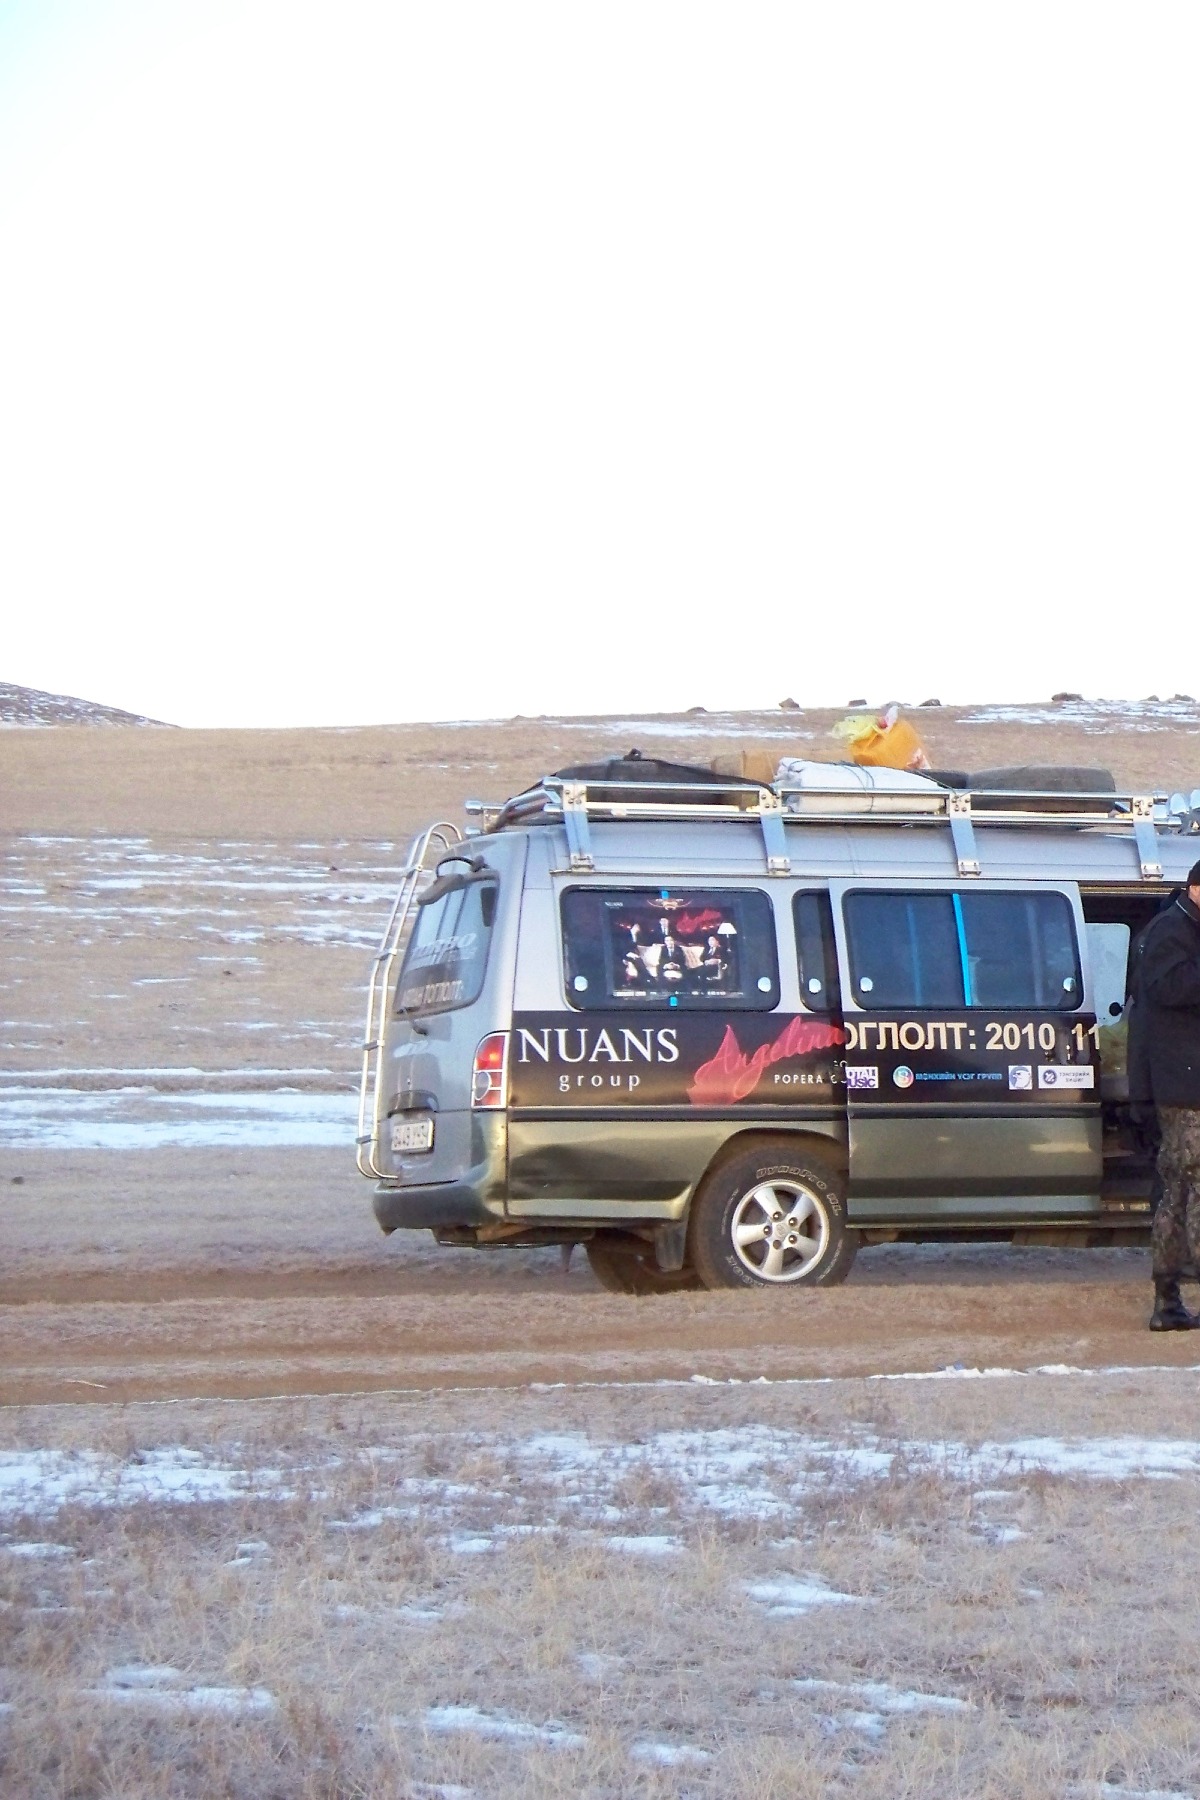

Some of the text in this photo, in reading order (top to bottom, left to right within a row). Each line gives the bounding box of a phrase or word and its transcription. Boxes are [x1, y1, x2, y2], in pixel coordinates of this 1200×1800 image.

[516, 1028, 680, 1063] NUANS
[985, 1022, 1055, 1050] 2010
[559, 1074, 640, 1092] group
[774, 1074, 824, 1084] POPERA
